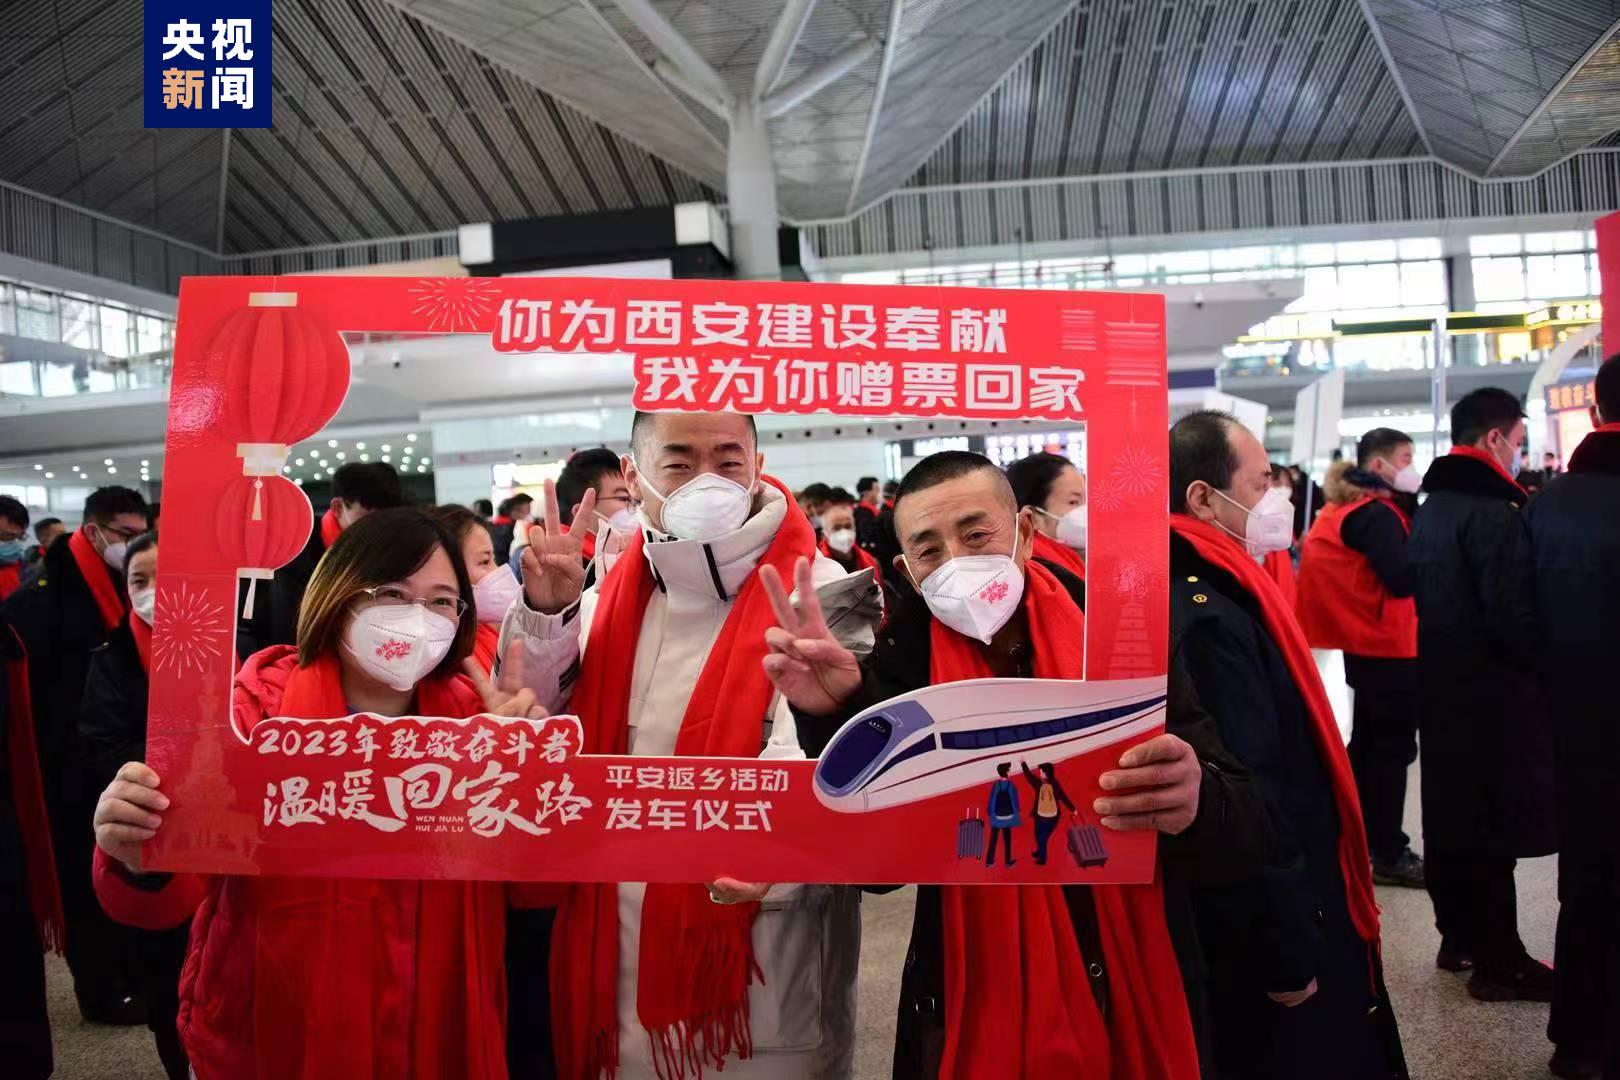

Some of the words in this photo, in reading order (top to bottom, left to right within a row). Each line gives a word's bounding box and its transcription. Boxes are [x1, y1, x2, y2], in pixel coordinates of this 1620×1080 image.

[498, 298, 1008, 354] 你为西安建设奉献
[641, 356, 1086, 413] 我为你赠票回家
[256, 726, 574, 766] 2023年致敬奋斗者
[263, 761, 593, 838] 温暖回家路
[605, 765, 789, 793] 平安返乡活动
[605, 797, 774, 832] 发车仪式
